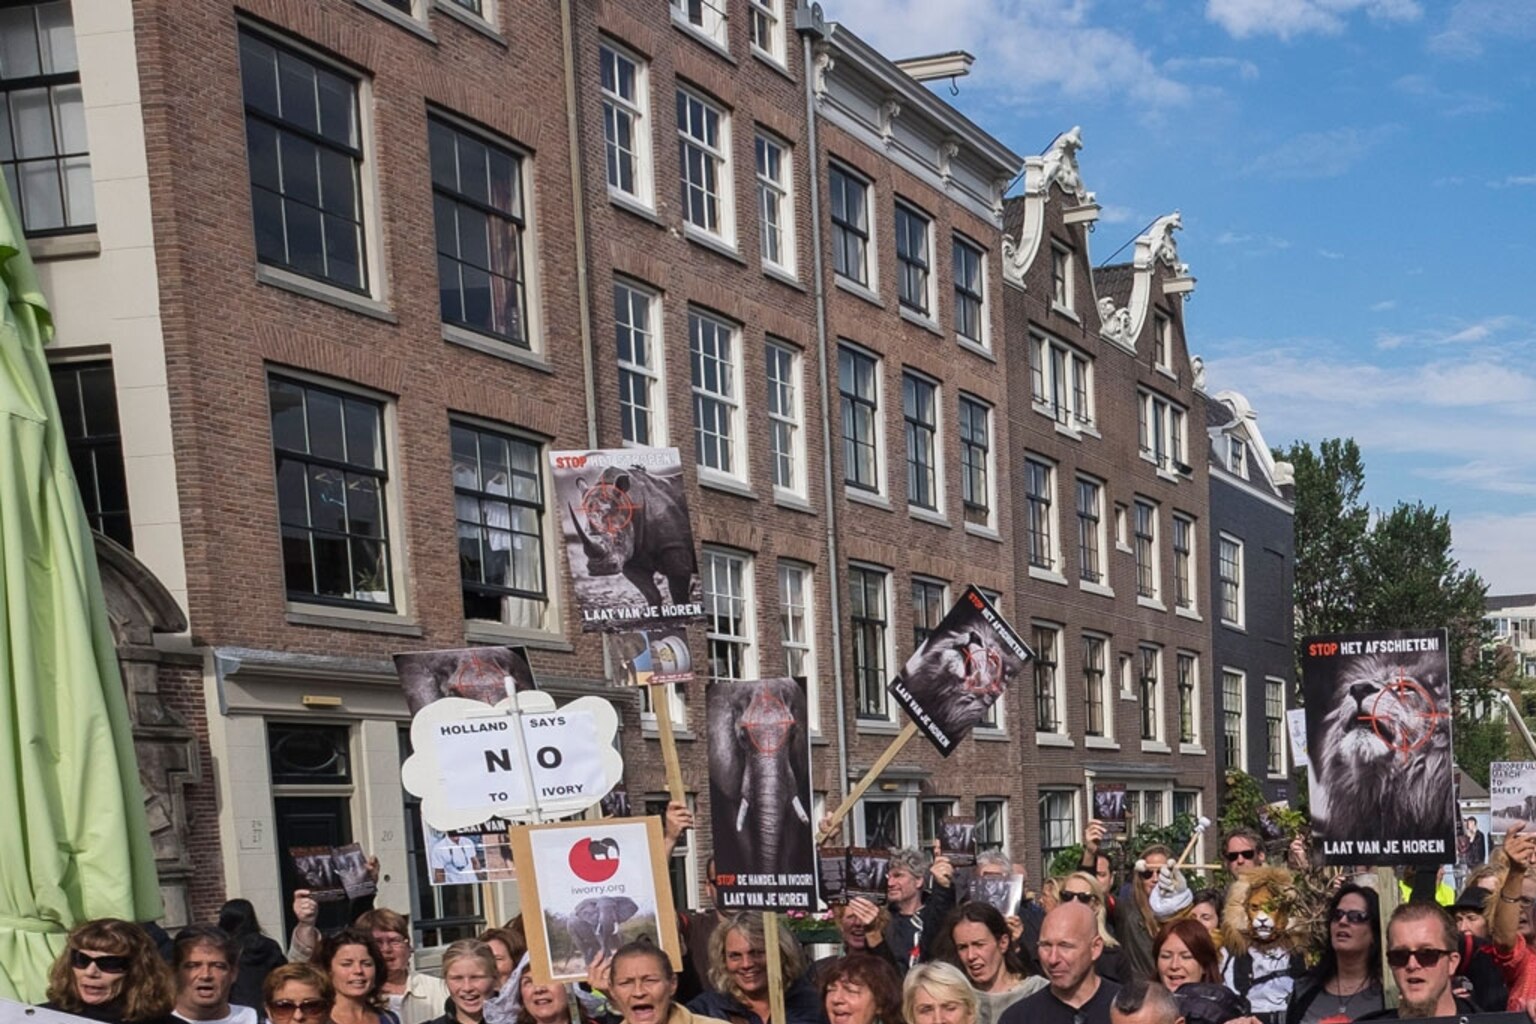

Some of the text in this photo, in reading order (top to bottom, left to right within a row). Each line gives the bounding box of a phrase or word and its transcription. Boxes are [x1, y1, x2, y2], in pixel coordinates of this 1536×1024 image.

[556, 456, 587, 468] STOP
[585, 603, 701, 621] LAAT VAN JE HOREN
[1309, 637, 1440, 657] STOP HET AFSCHIETEN!
[441, 721, 508, 736] HOLLAND
[529, 716, 566, 728] SAYS
[542, 784, 583, 796] IVORY
[489, 792, 508, 802] TO
[1324, 839, 1445, 855] LAAT VAN JE HOREN
[717, 875, 735, 886] STOP
[737, 874, 747, 886] DE
[748, 874, 777, 886] HANDEL
[571, 883, 625, 896] iworry.org
[724, 892, 809, 907] LAAT VAN JE HOREN
